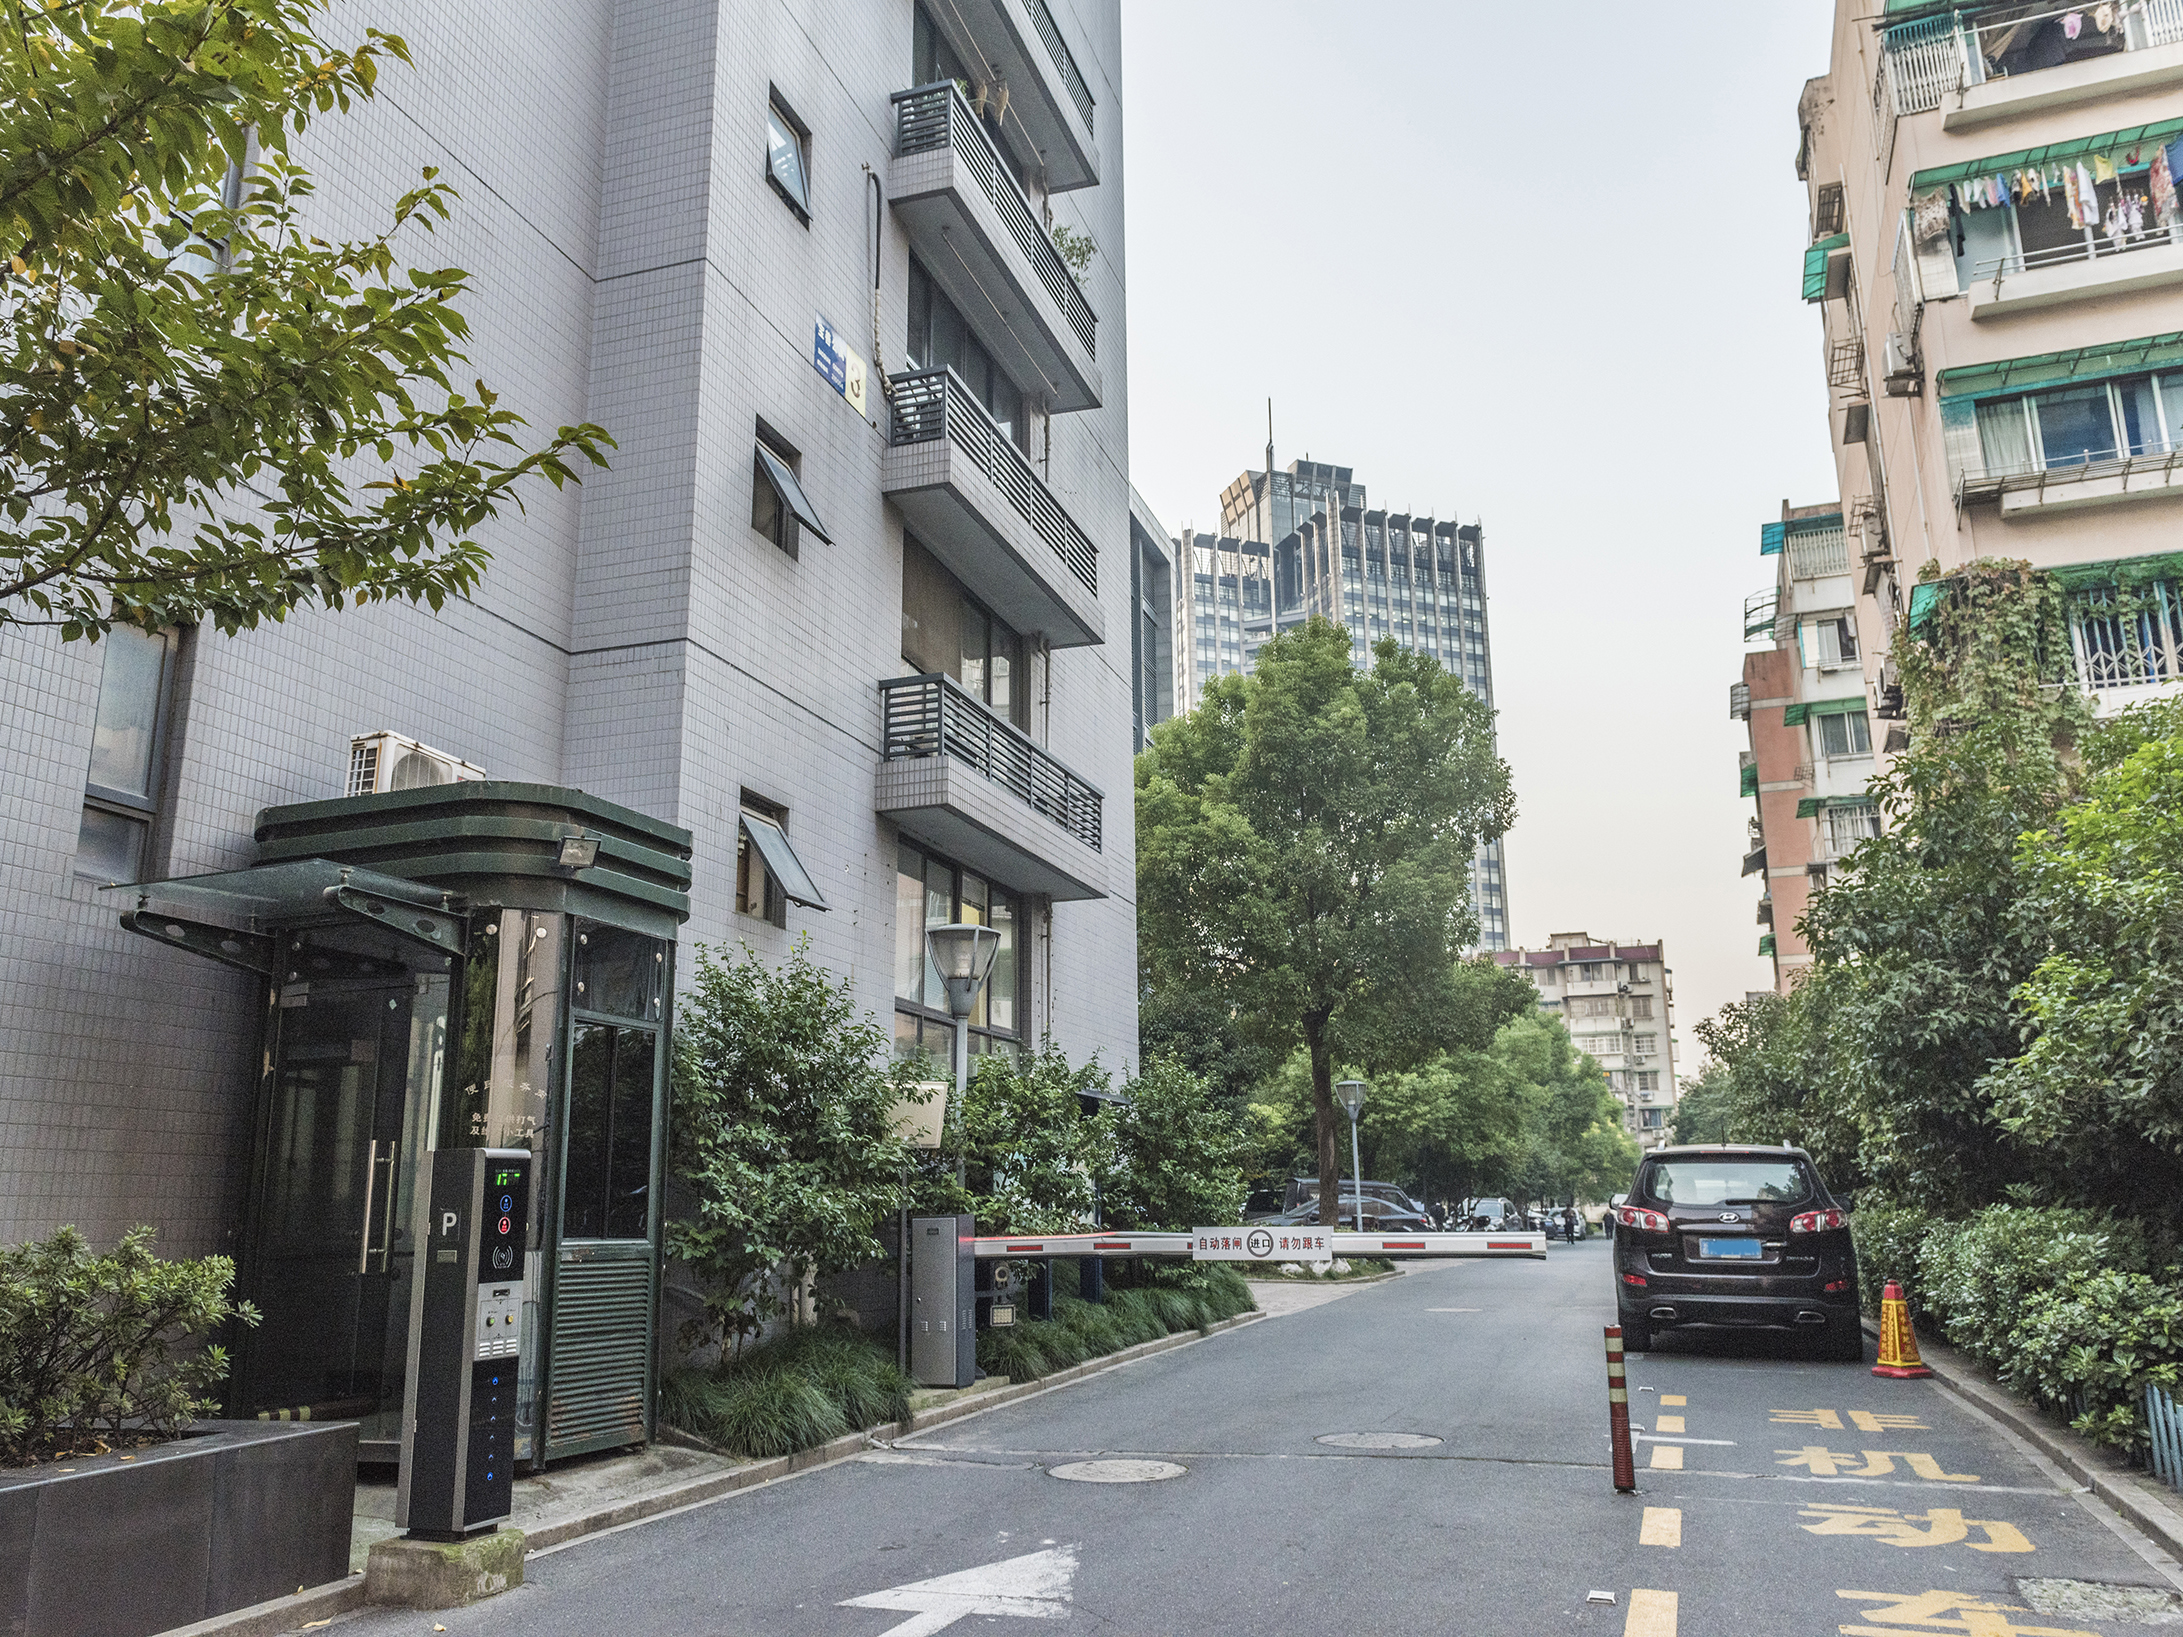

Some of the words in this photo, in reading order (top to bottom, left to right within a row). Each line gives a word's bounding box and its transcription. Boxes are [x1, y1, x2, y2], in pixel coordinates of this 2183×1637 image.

[472, 1112, 536, 1126] 免供打气
[470, 1125, 535, 1139] 及小工具
[442, 1212, 457, 1236] P
[1199, 1236, 1242, 1250] 自动落闸
[1250, 1238, 1271, 1249] 进口
[1279, 1236, 1325, 1250] 请勿跟车
